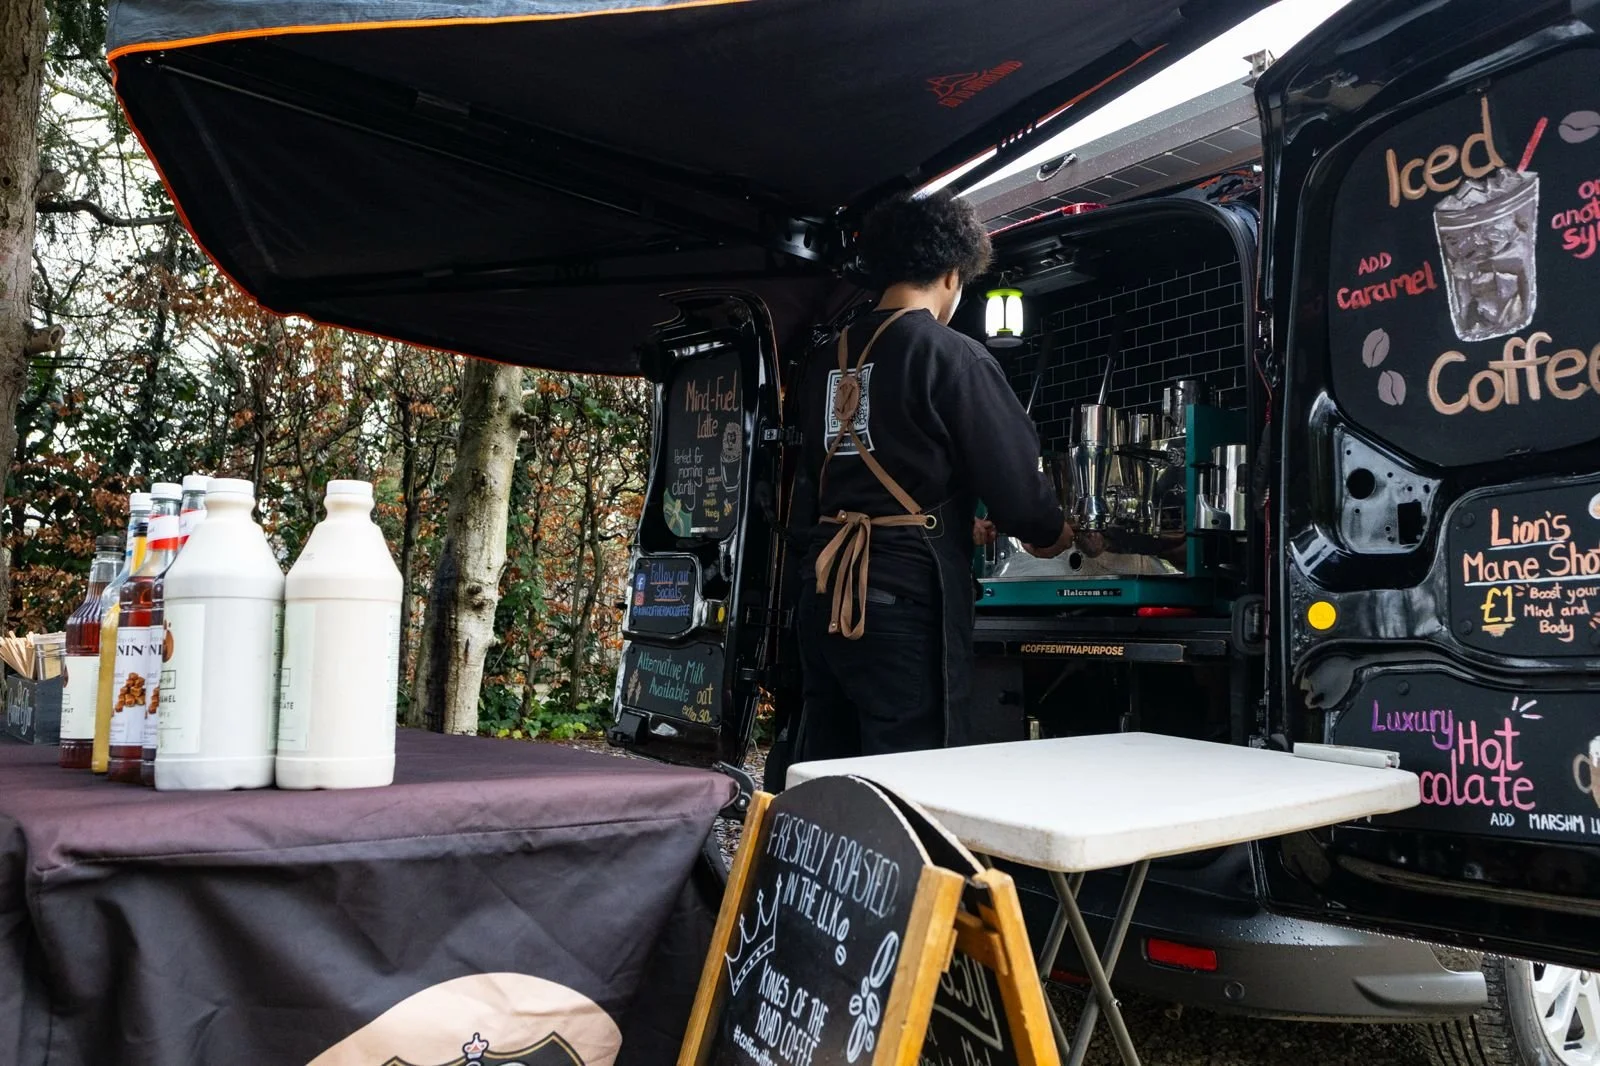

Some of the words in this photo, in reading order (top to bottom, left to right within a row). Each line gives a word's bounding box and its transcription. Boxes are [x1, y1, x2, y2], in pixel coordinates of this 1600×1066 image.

[1385, 95, 1507, 208] Iced
[1358, 252, 1392, 275] ADD
[1337, 261, 1437, 310] Caramel
[685, 370, 739, 412] Mind-Fuel
[697, 413, 718, 439] Latte
[674, 449, 692, 465] Perfect
[694, 447, 704, 464] for
[678, 467, 703, 487] morning
[672, 480, 696, 511] clarity
[1490, 507, 1571, 546] Lion's
[651, 563, 674, 582] Follow
[1462, 553, 1540, 583] Mane
[655, 584, 682, 599] Socials
[1480, 586, 1516, 623] £1
[1566, 587, 1600, 605] your
[1524, 602, 1554, 617] Mind
[1561, 600, 1590, 617] and
[1539, 619, 1574, 643] Body
[1021, 644, 1124, 656] #COFFEEWITHAPURPOSE
[637, 650, 682, 681] Alternative
[683, 660, 705, 684] Milk
[648, 677, 689, 702] Available
[696, 684, 713, 706] oat
[1371, 699, 1454, 749] Luxury
[1458, 717, 1524, 771] Hot
[1420, 749, 1536, 811] colate
[1490, 812, 1515, 827] ADD
[783, 871, 799, 906] IN
[758, 957, 790, 1008] KINGS
[791, 987, 809, 1019] OF
[807, 997, 829, 1042] THE
[755, 1001, 782, 1048] ROAD
